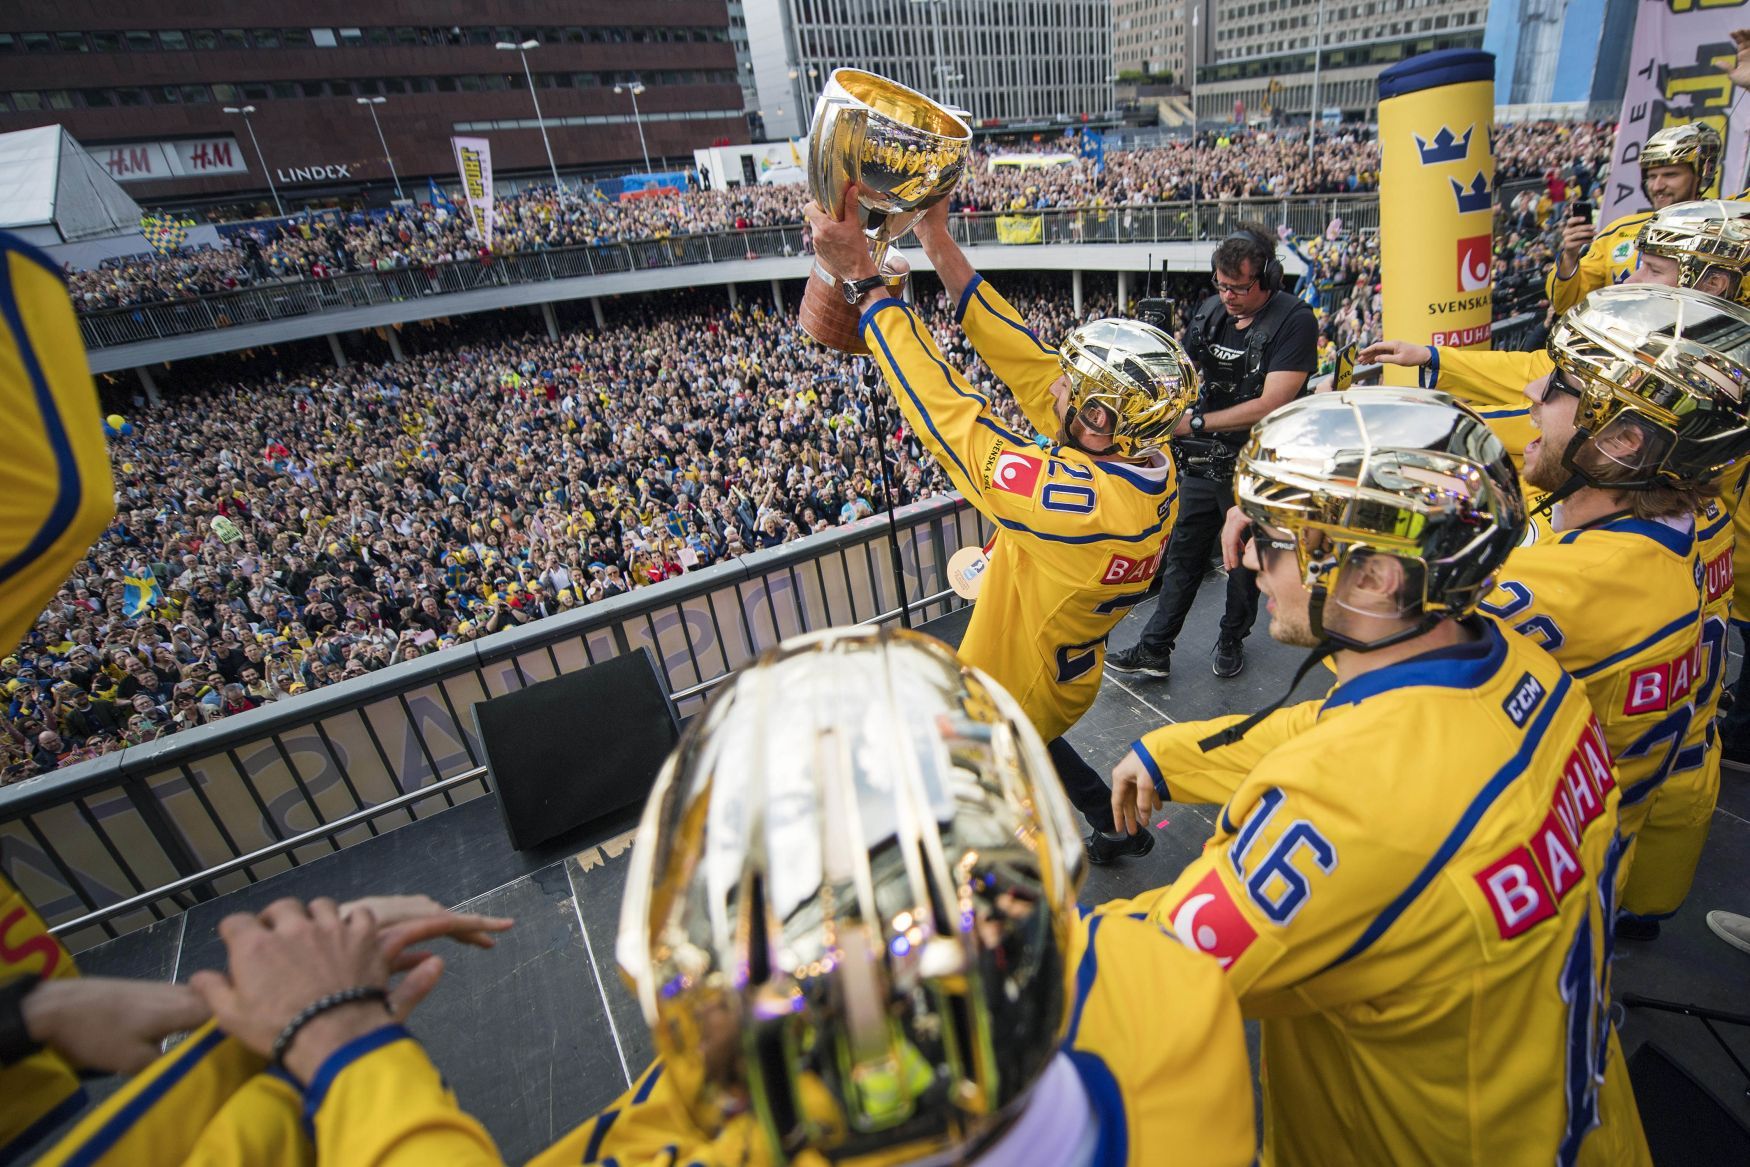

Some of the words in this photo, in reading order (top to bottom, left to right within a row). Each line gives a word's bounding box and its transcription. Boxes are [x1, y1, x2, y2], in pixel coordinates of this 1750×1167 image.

[277, 164, 351, 182] LINDEX
[1428, 295, 1489, 315] SVENSKA
[984, 438, 1004, 473] SVENSKA
[1041, 456, 1097, 515] 20
[1506, 675, 1542, 722] CCM
[1228, 786, 1339, 928] 16
